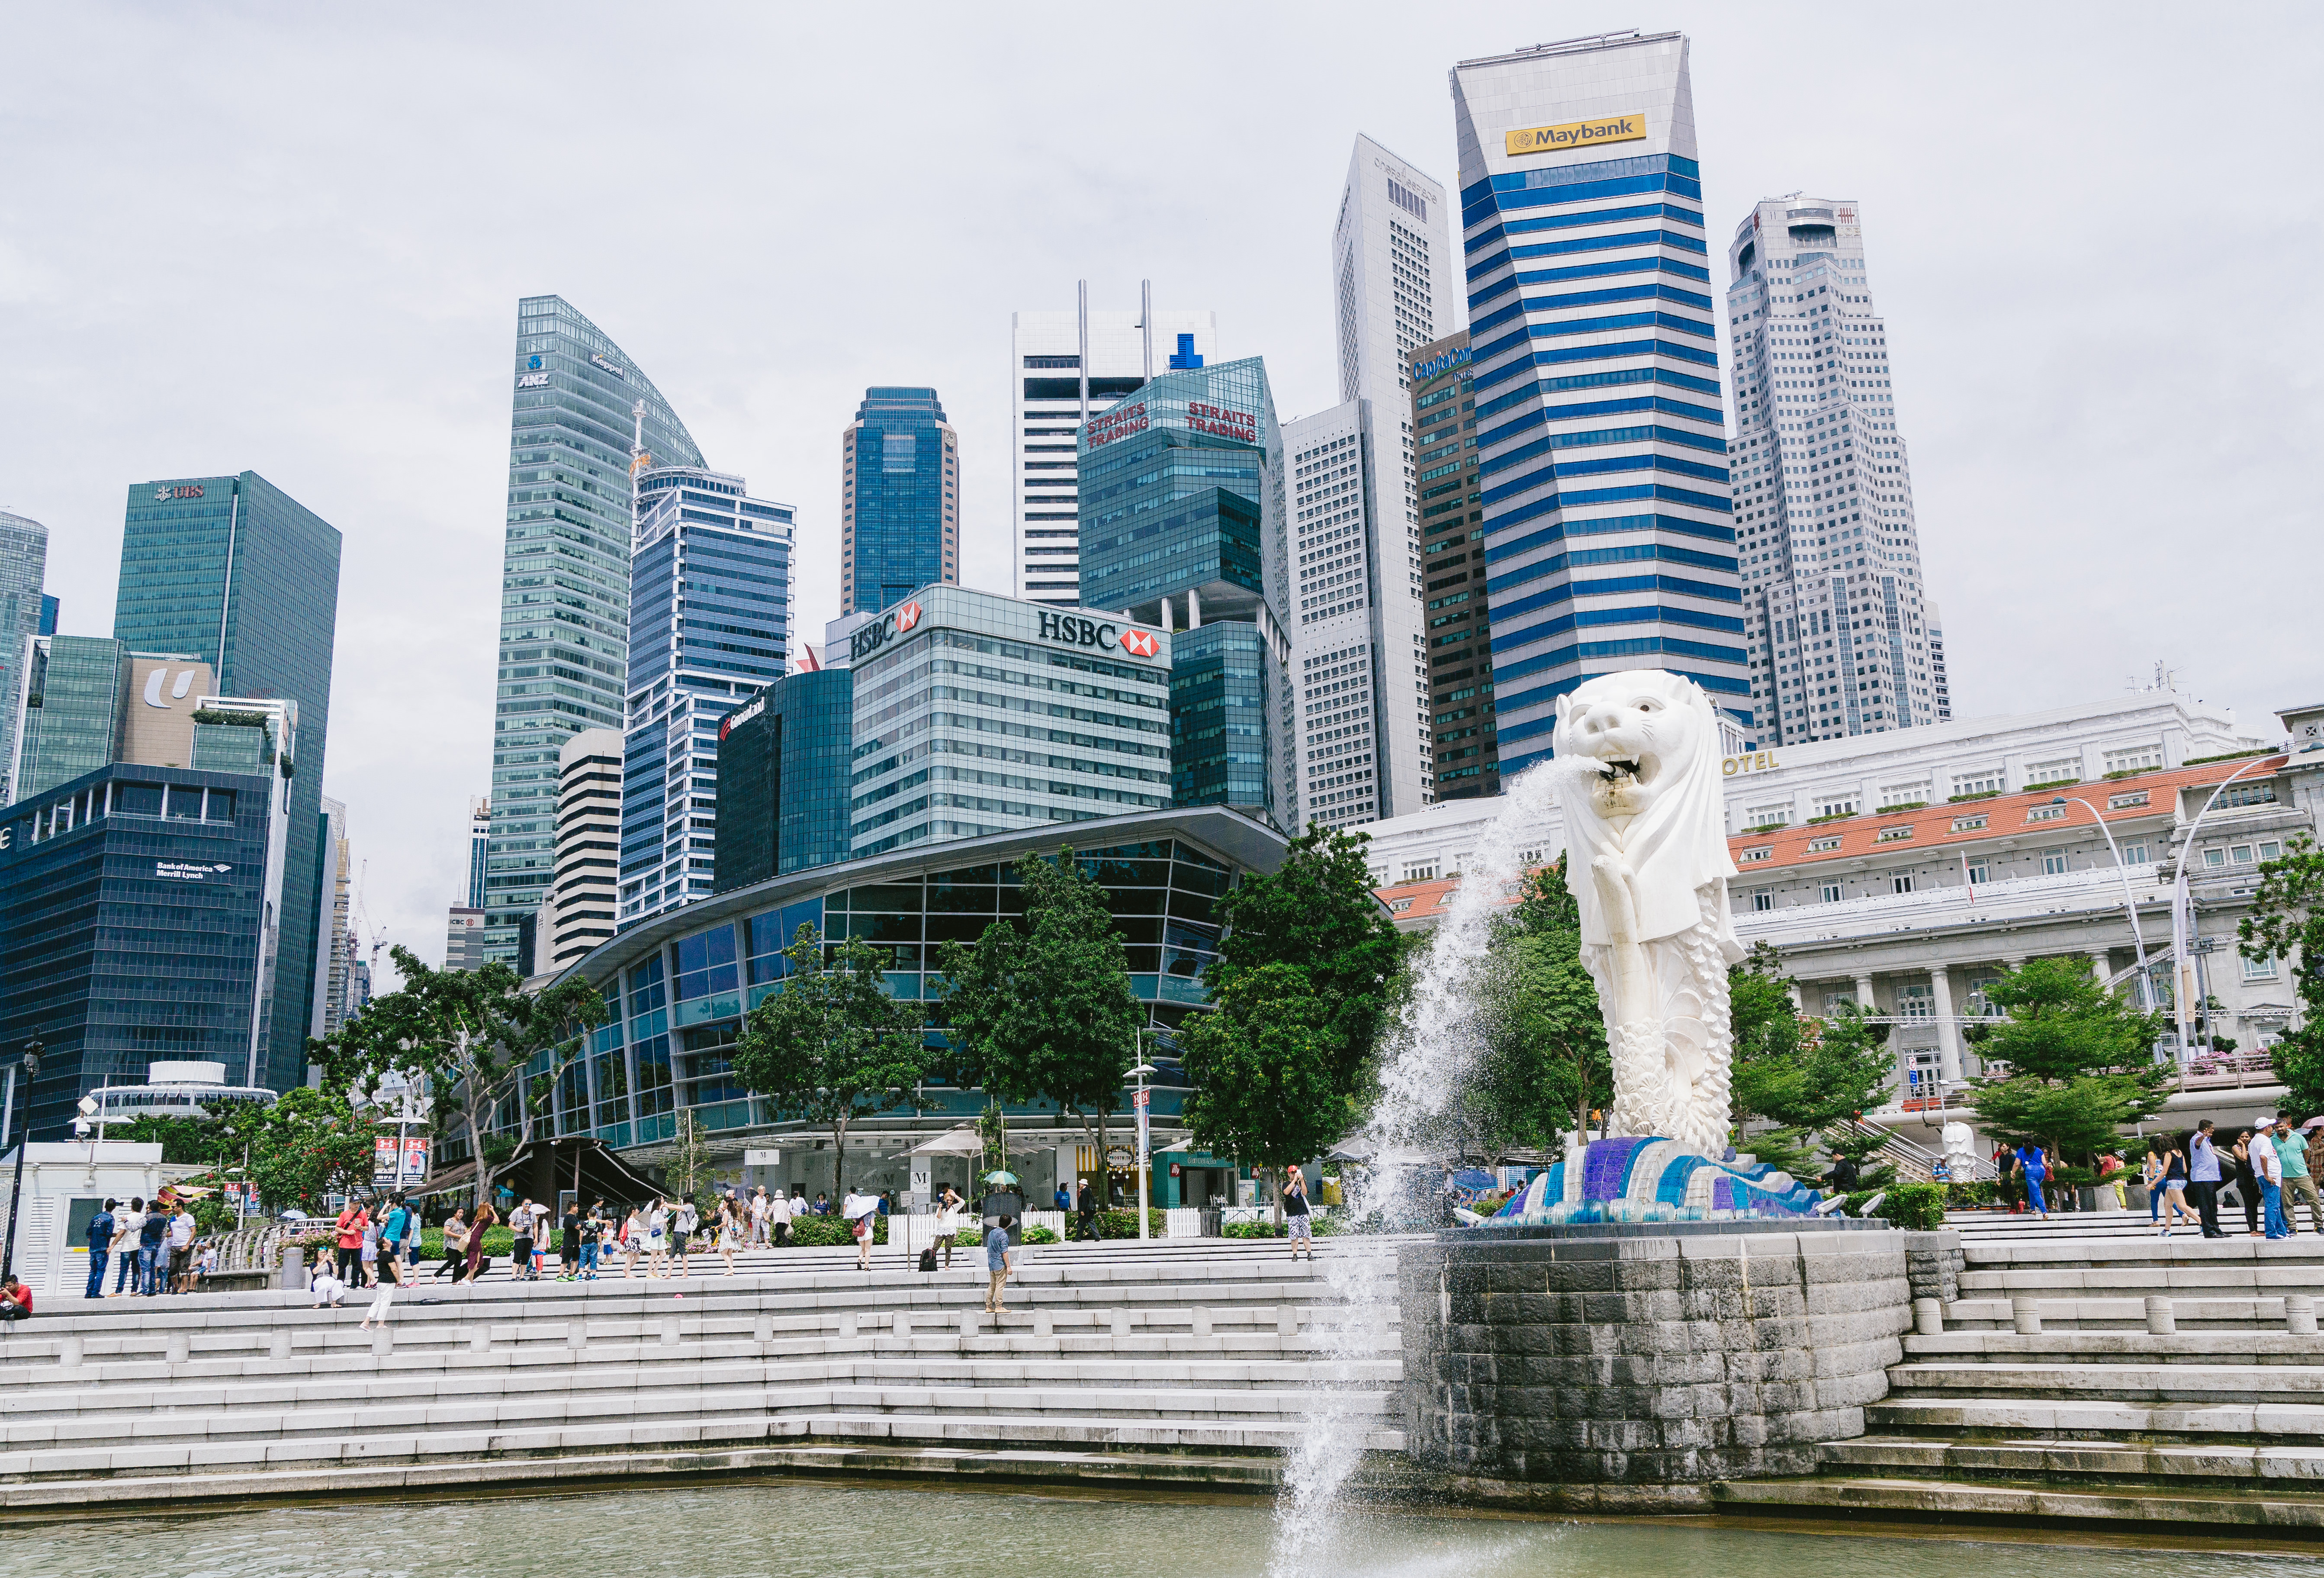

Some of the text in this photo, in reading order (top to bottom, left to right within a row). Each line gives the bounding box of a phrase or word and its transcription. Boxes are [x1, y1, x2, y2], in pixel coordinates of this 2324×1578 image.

[1536, 119, 1634, 145] Maybank
[1835, 227, 1861, 236] UOB
[592, 354, 623, 376] Keppel
[1452, 368, 1473, 383] Trust
[518, 374, 549, 387] ANZ
[1087, 403, 1146, 433] STRAITS
[1189, 402, 1256, 426] STRAITS
[1087, 416, 1149, 448] TRADING
[1185, 415, 1256, 441] TRADING
[174, 485, 204, 498] UBS
[849, 612, 895, 662] HSBC
[1038, 611, 1117, 650] HSBC
[730, 696, 765, 730] GuocoLand
[1722, 750, 1779, 775] OTEL
[183, 864, 213, 873] America
[915, 1172, 927, 1183] M
